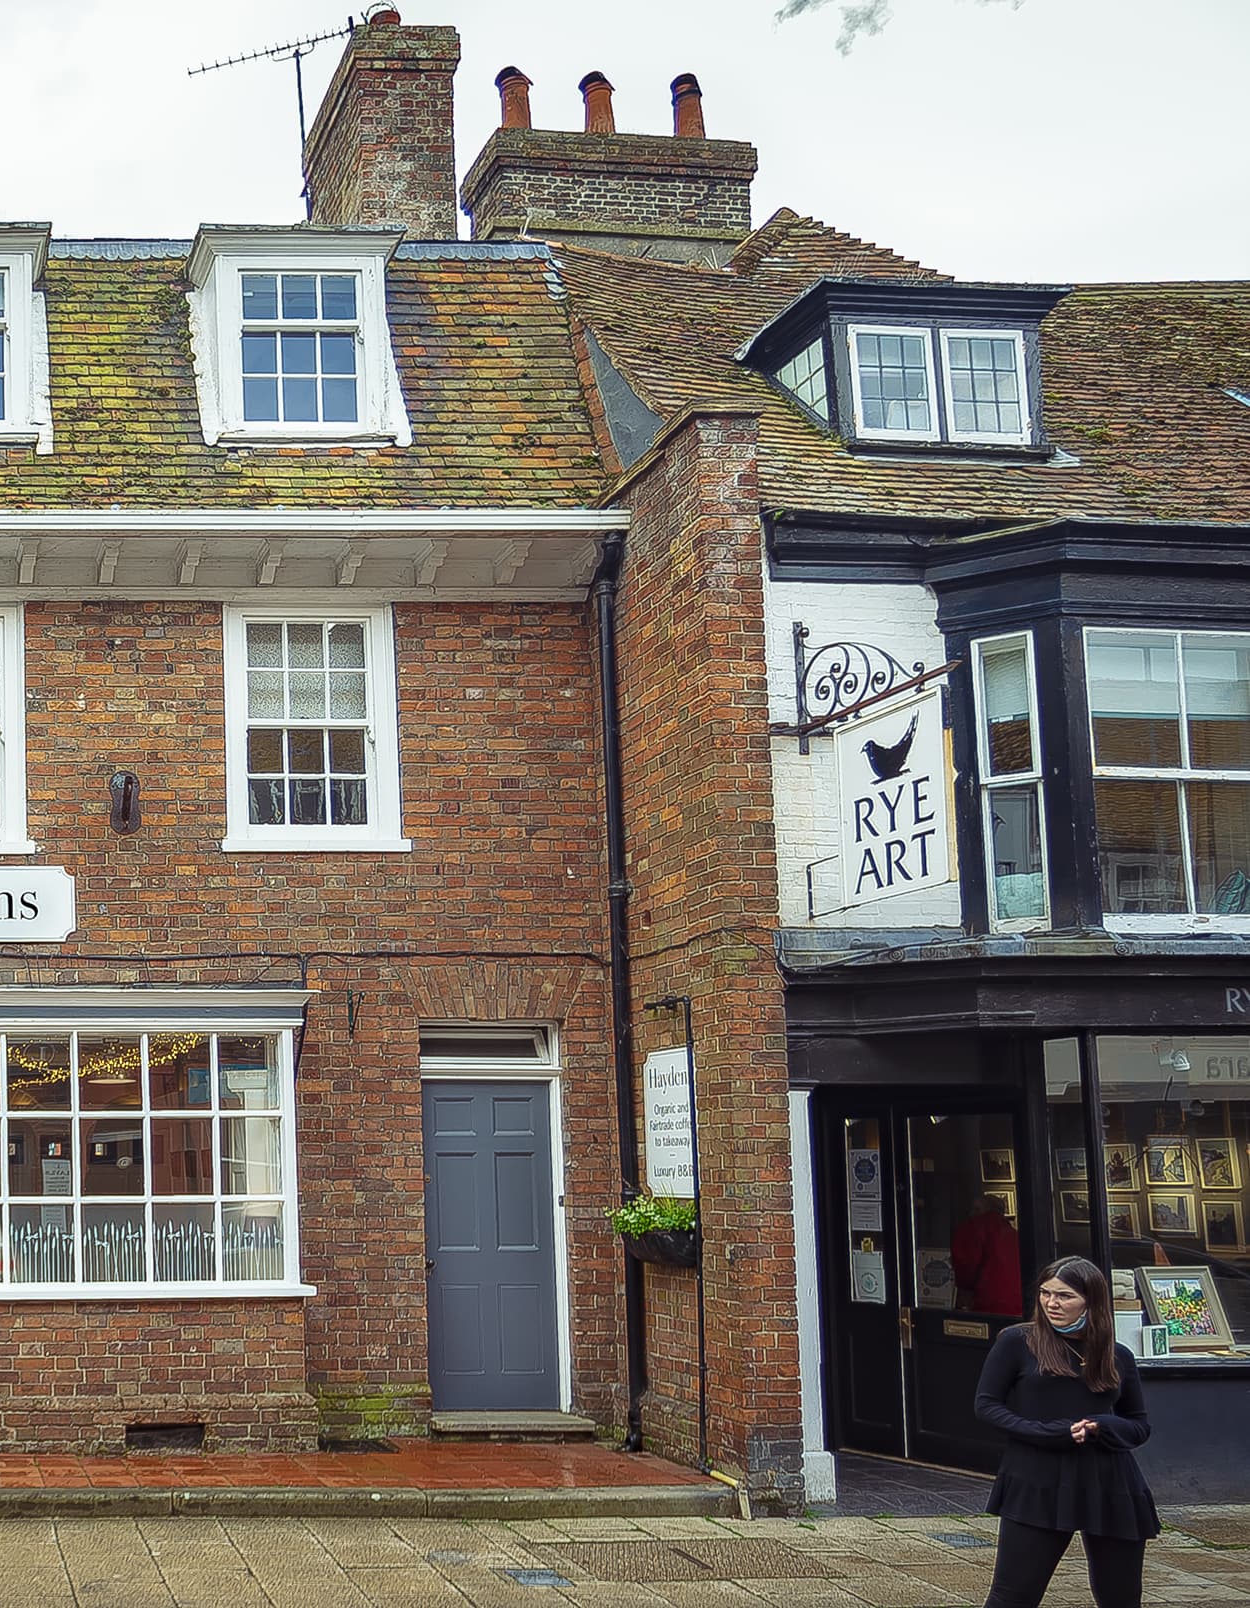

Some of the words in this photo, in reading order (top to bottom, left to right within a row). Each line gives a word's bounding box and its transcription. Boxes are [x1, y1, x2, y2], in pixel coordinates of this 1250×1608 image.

[853, 776, 936, 843] RYE
[854, 828, 936, 895] ART
[649, 1065, 688, 1095] Hayden
[653, 1101, 676, 1117] Organic
[677, 1101, 689, 1114] and
[649, 1118, 674, 1132] Fairtrade
[654, 1136, 661, 1147] to
[654, 1164, 676, 1180] Luxury
